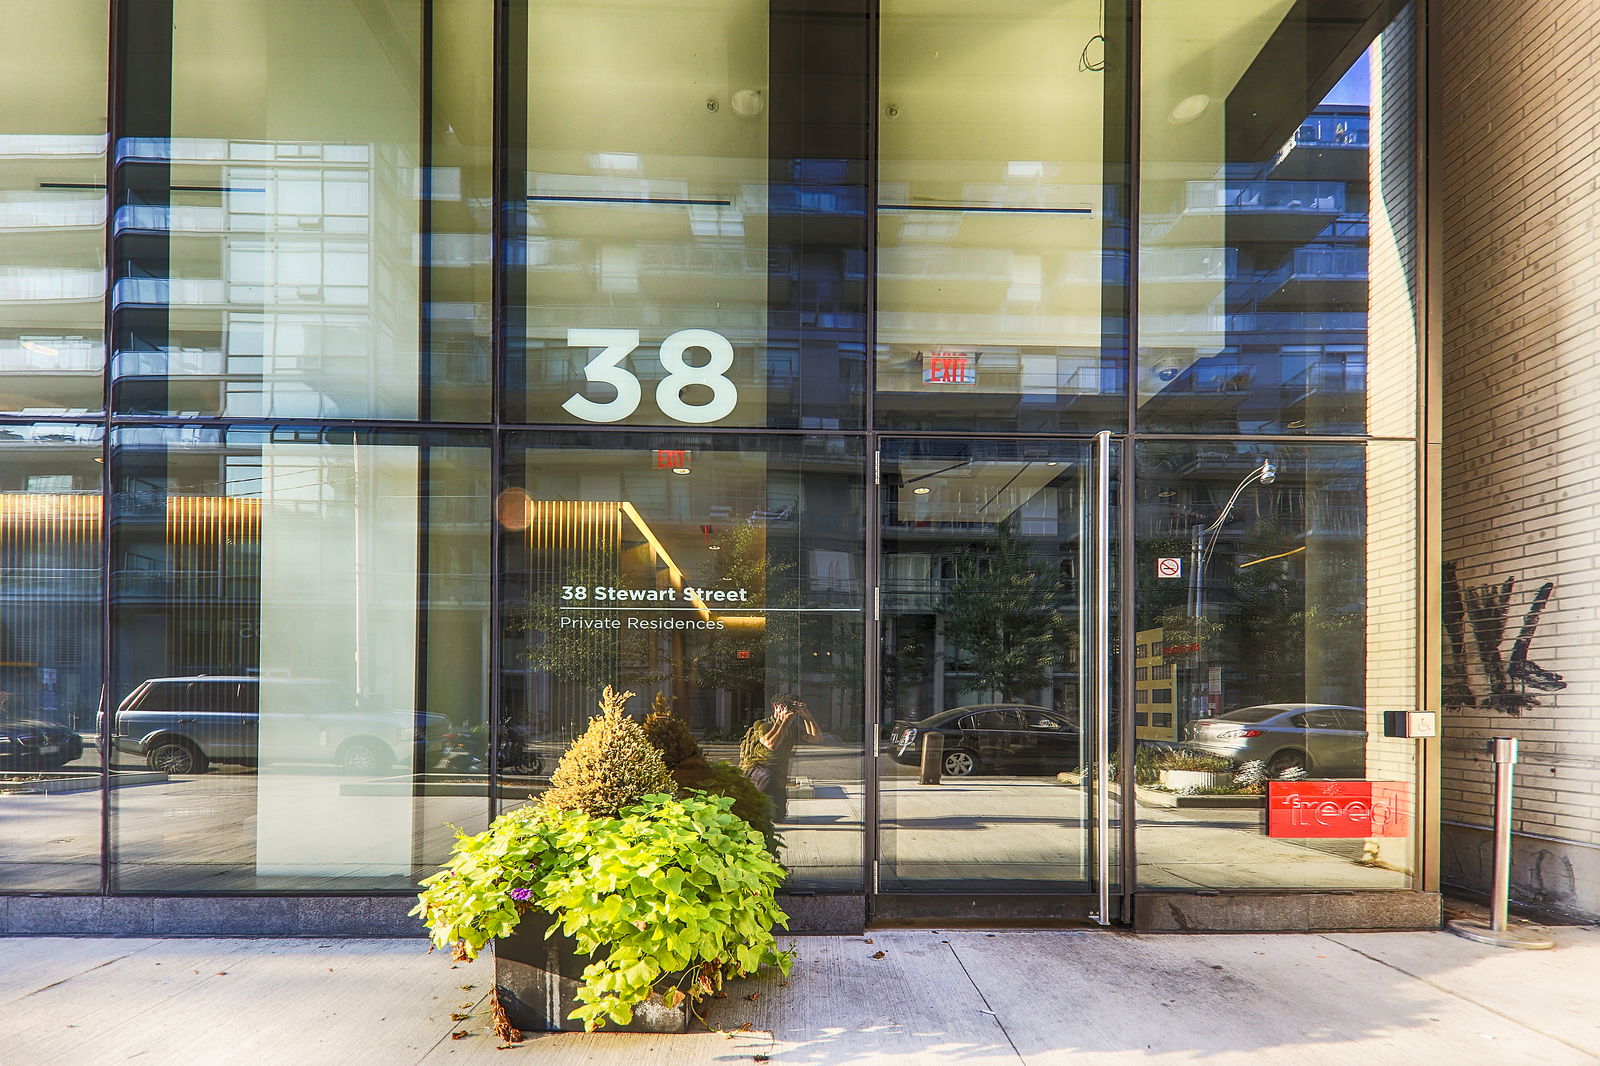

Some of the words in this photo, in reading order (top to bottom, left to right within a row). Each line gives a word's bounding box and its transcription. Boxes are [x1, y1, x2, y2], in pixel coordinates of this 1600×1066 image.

[561, 328, 738, 423] 38
[930, 358, 967, 383] EXIT
[657, 450, 686, 468] EXIT
[561, 586, 587, 600] 38
[594, 586, 676, 601] Stewart
[682, 587, 748, 602] Street
[560, 616, 621, 629] Private
[627, 616, 724, 630] Residences
[1281, 793, 1398, 826] freed
